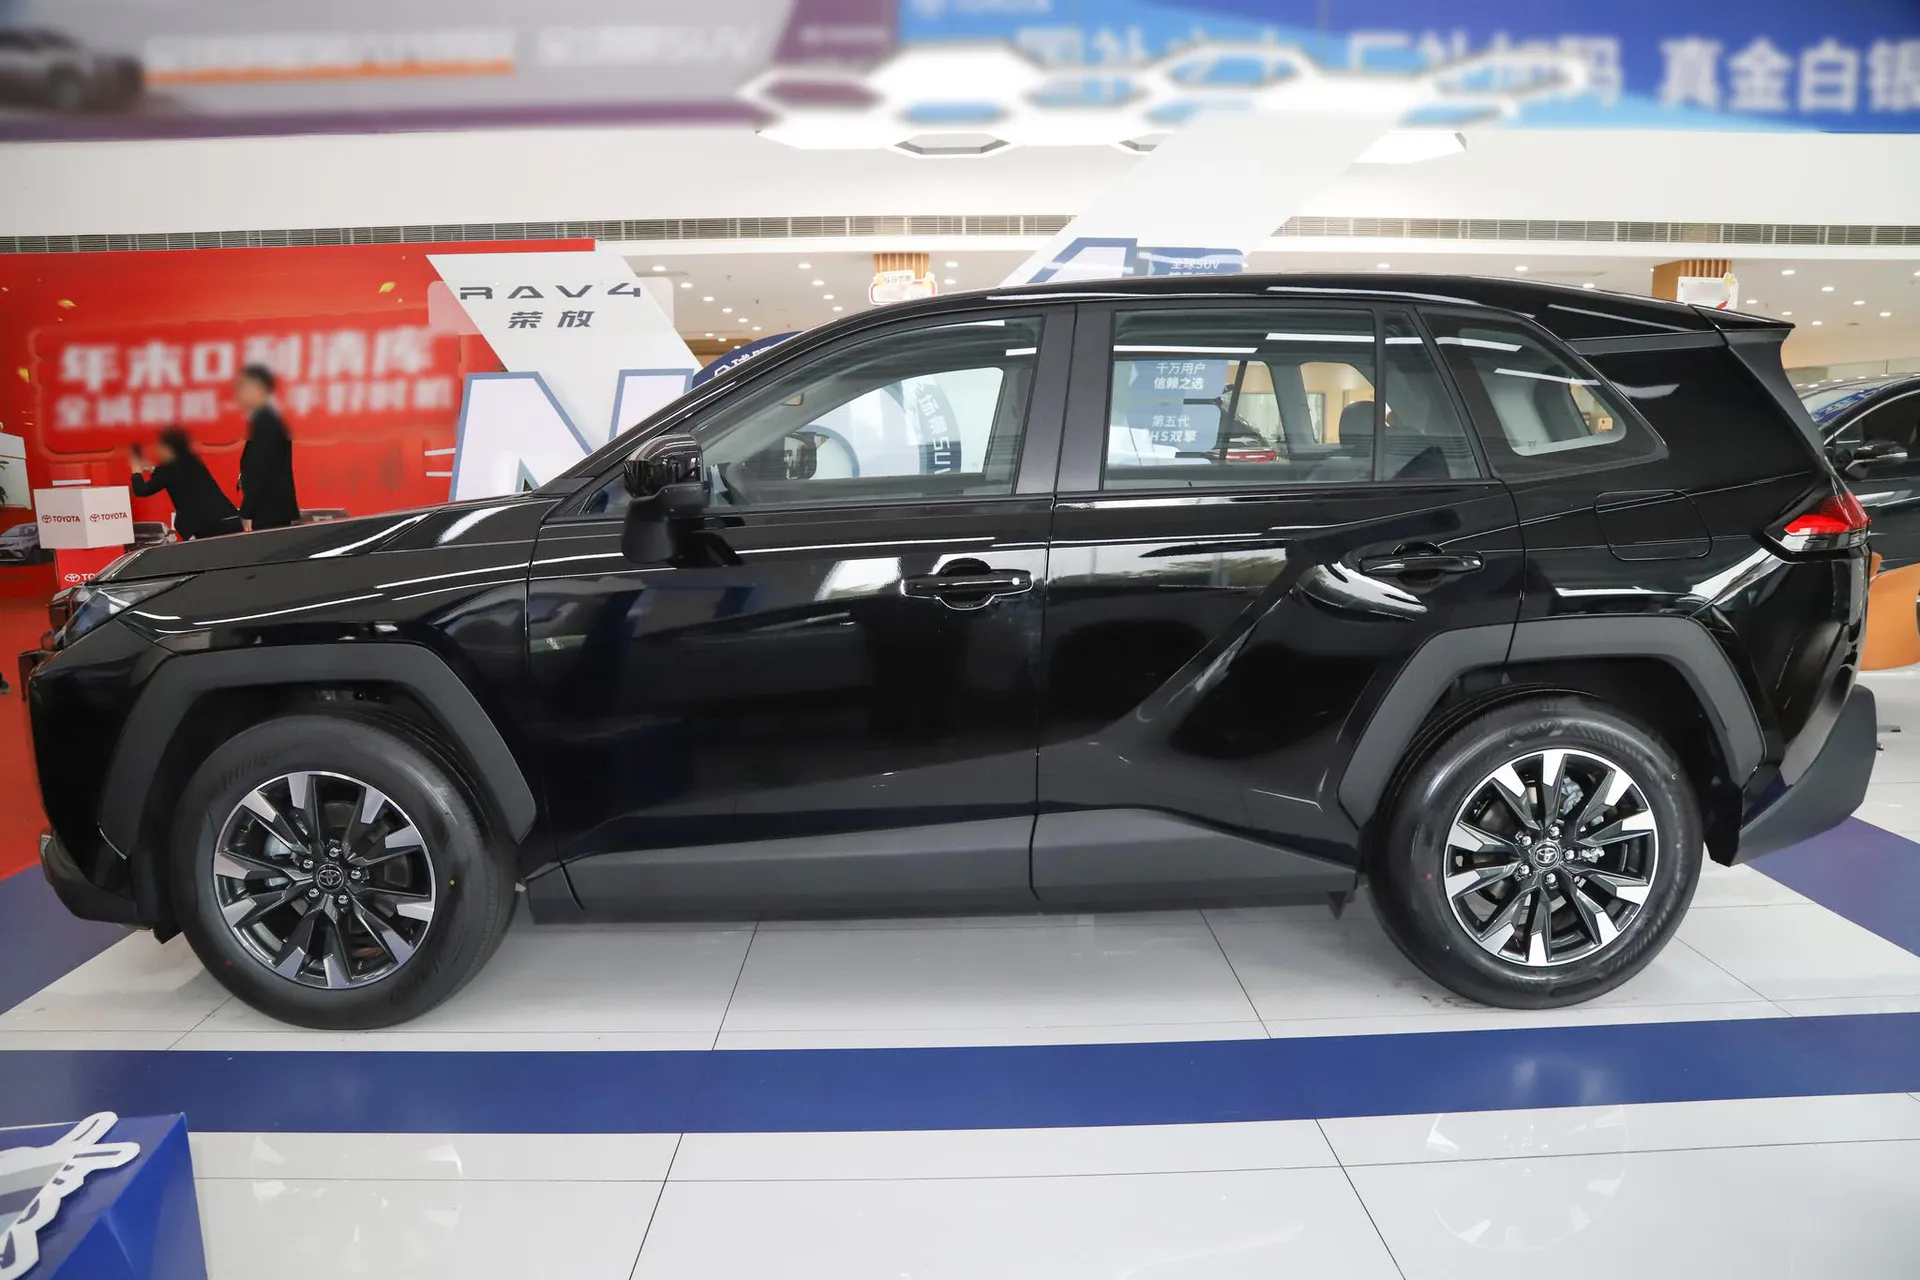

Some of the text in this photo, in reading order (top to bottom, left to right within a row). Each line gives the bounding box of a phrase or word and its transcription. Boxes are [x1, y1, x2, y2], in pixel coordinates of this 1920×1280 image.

[460, 283, 641, 299] RAV4
[508, 310, 595, 328] 荣放
[1157, 362, 1205, 374] 千万用户
[1153, 377, 1204, 390] 信赖之选
[1152, 414, 1190, 427] 第五代
[101, 512, 127, 520] TOYOTA
